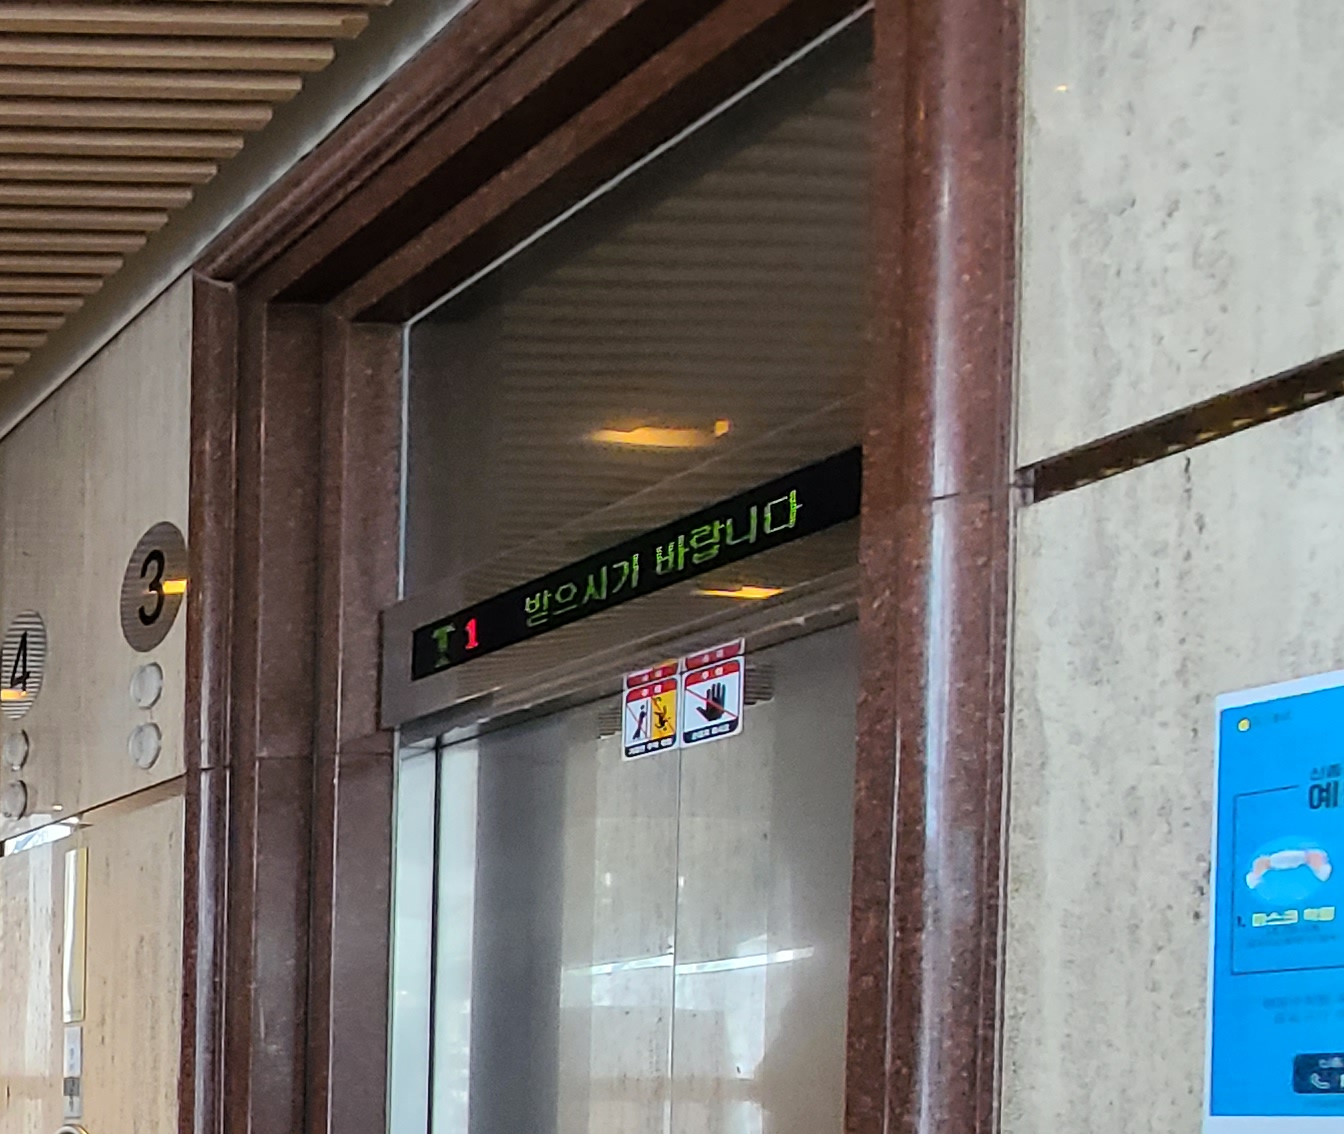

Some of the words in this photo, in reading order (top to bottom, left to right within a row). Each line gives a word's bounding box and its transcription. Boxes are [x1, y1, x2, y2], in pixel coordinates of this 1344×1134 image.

[137, 549, 165, 627] 3
[464, 617, 480, 650] 1
[524, 553, 640, 628] 받으시기
[655, 488, 803, 577] 바랍니다
[10, 630, 31, 692] 4
